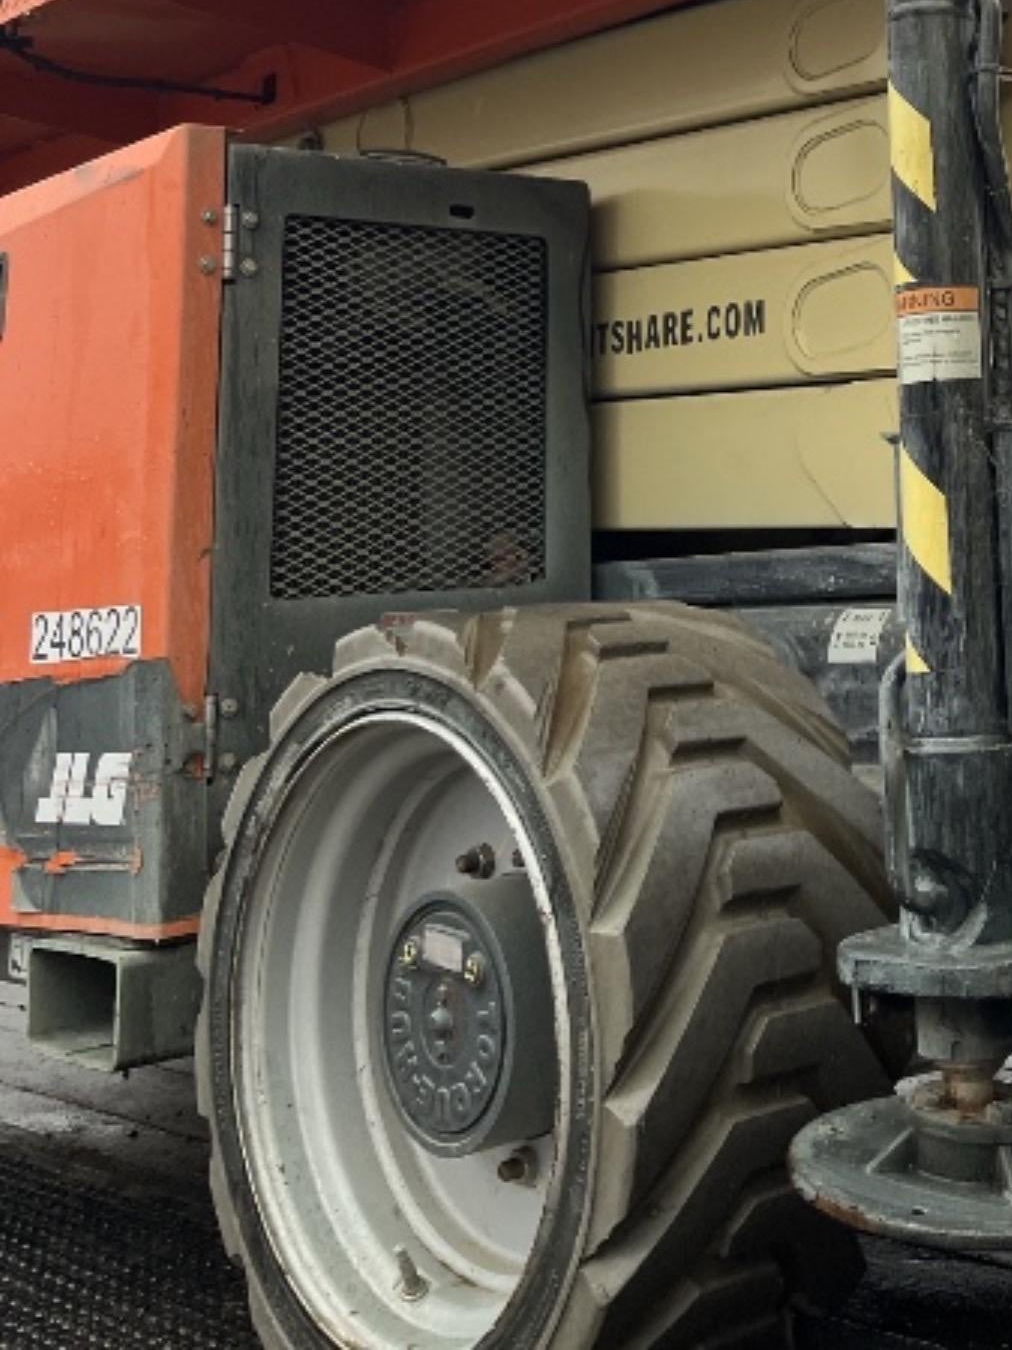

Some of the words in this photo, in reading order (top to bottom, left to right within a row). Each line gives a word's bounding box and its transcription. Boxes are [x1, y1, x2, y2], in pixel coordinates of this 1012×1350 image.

[592, 299, 767, 355] TSHARE.COM
[32, 608, 139, 661] 248622
[34, 752, 133, 826] JLG
